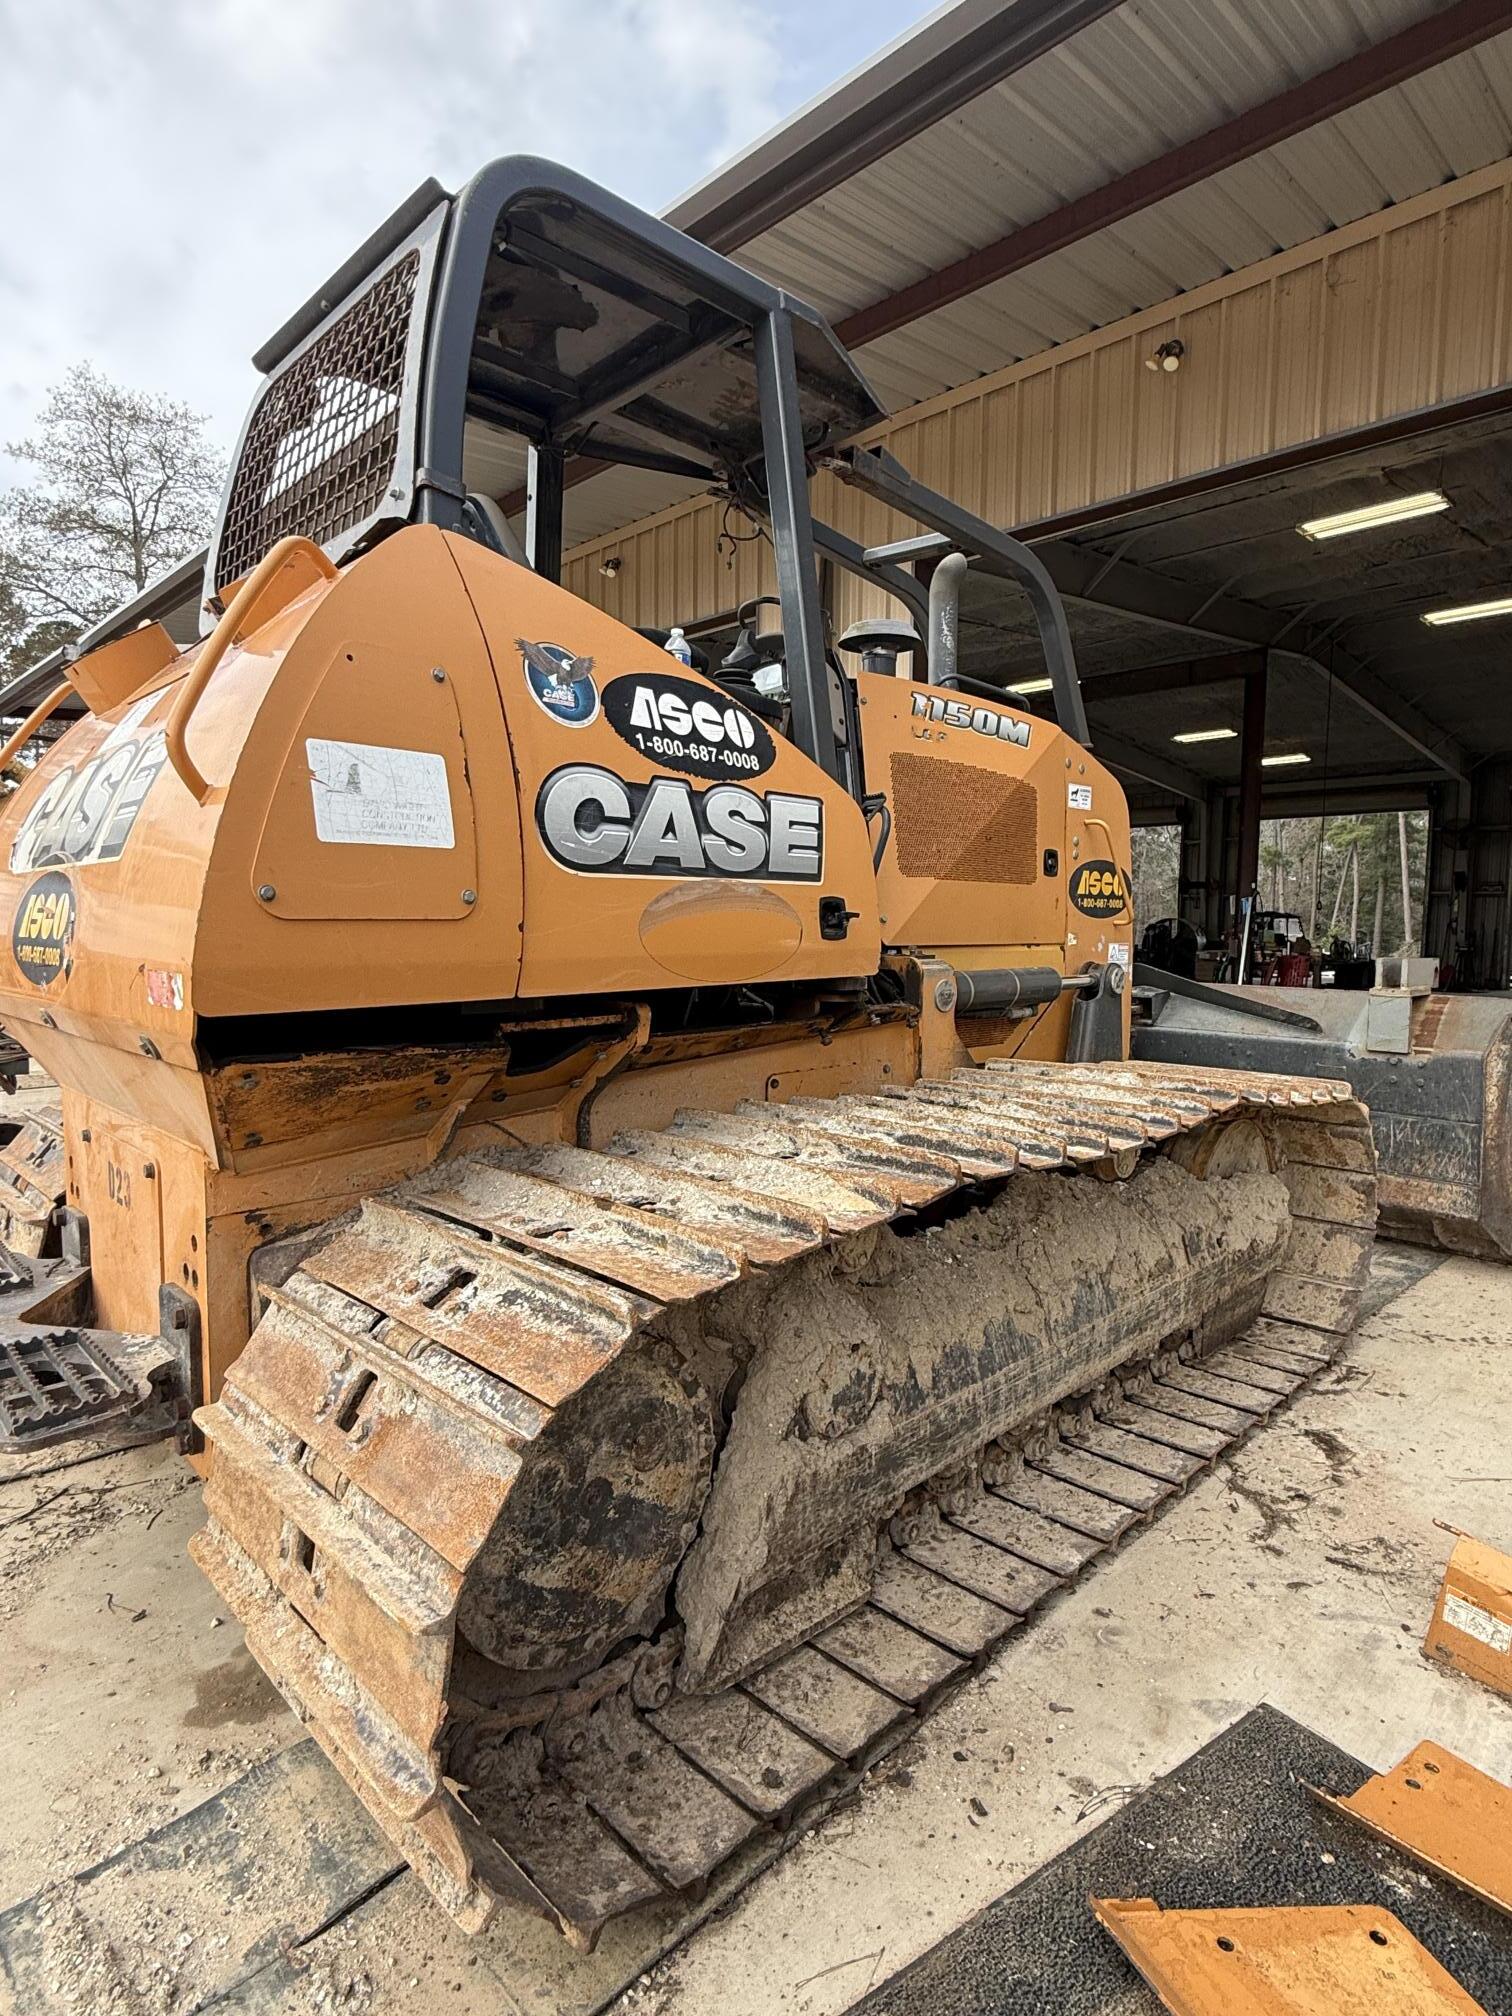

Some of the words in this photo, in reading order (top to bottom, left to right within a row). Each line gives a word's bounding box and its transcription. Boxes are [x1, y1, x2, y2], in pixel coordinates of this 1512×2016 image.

[542, 688, 575, 702] CASE
[630, 686, 755, 749] ASCO
[911, 691, 1032, 749] 1150M
[635, 732, 760, 771] 1-800-687-0008
[9, 729, 168, 874] CASE
[535, 762, 824, 884] CASE
[18, 892, 70, 940] ASCO
[108, 1160, 132, 1212] D23
